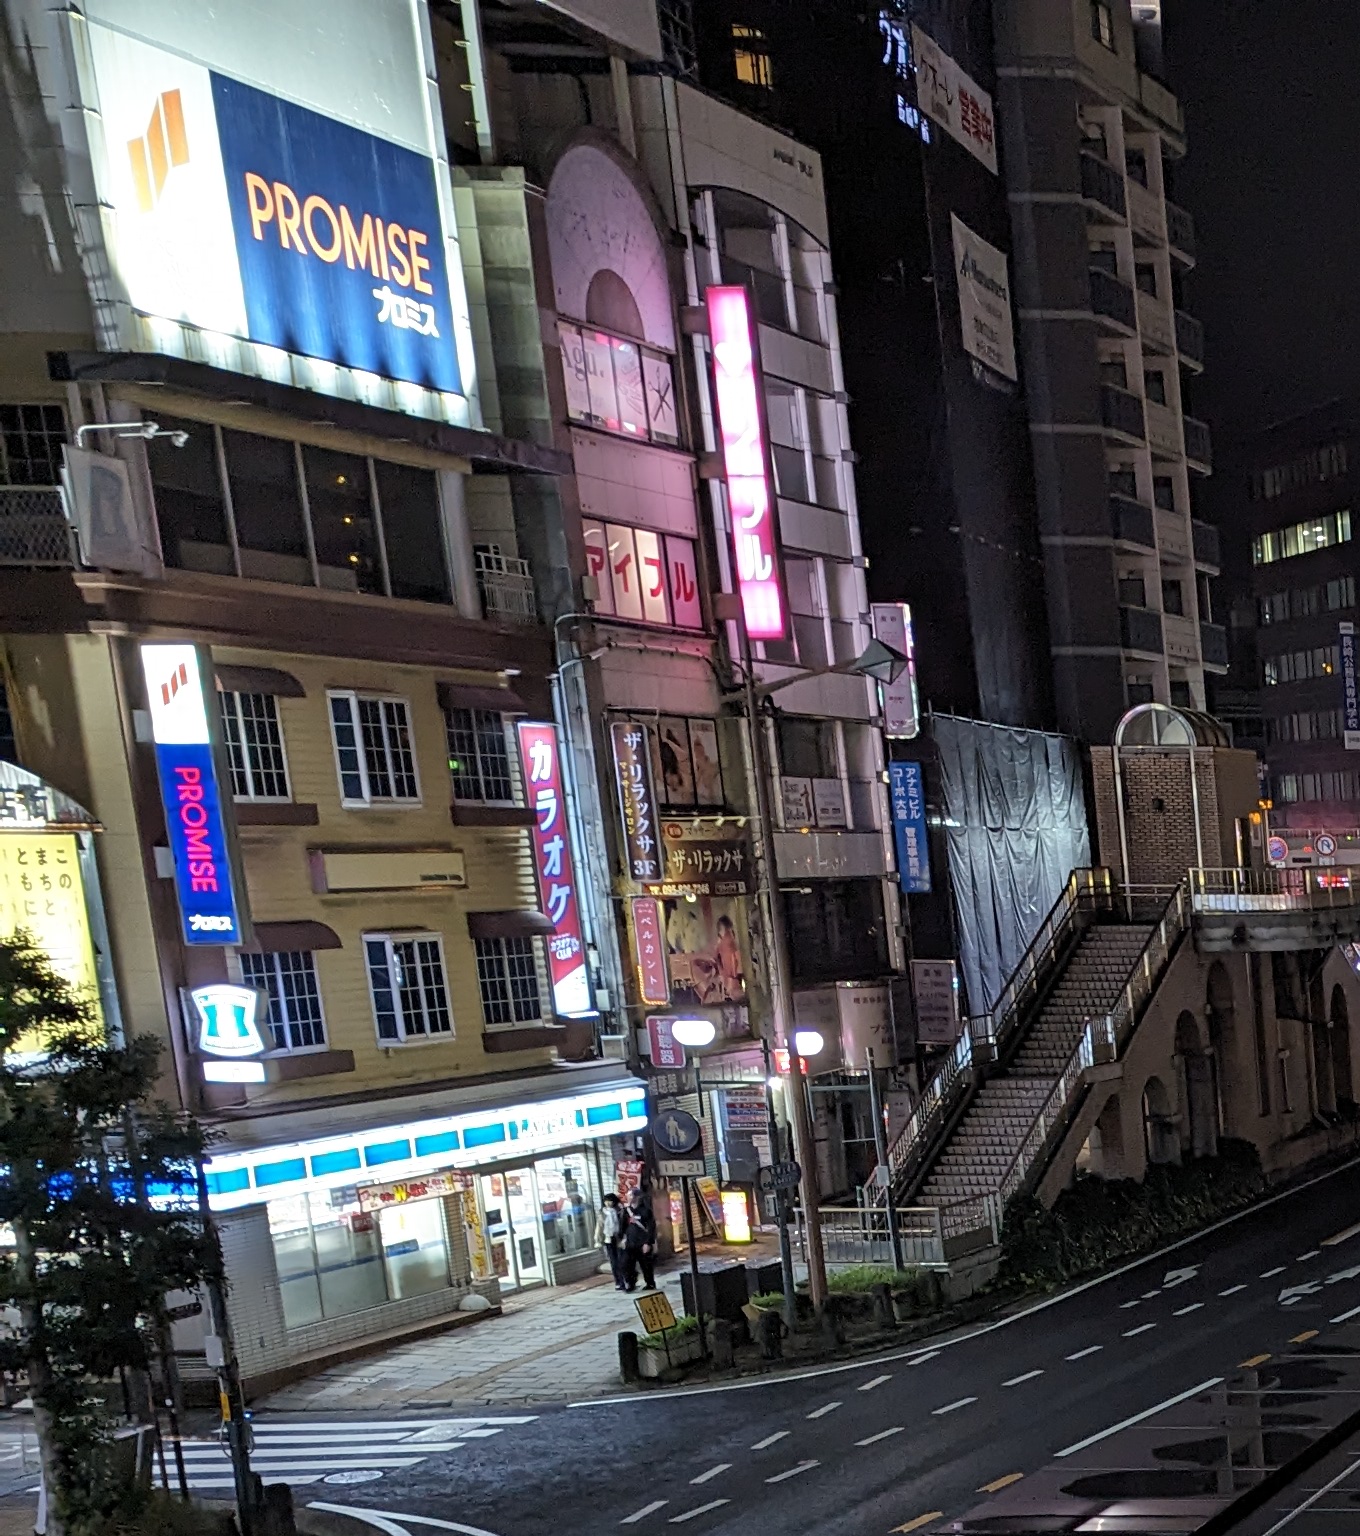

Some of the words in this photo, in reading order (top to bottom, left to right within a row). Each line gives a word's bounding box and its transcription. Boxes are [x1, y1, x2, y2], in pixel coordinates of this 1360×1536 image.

[245, 171, 434, 296] PROMISE
[372, 285, 440, 338] プロミス
[175, 767, 218, 892] PROMISE
[529, 738, 570, 924] カラオケ
[623, 732, 655, 854] ザ・リラックサ
